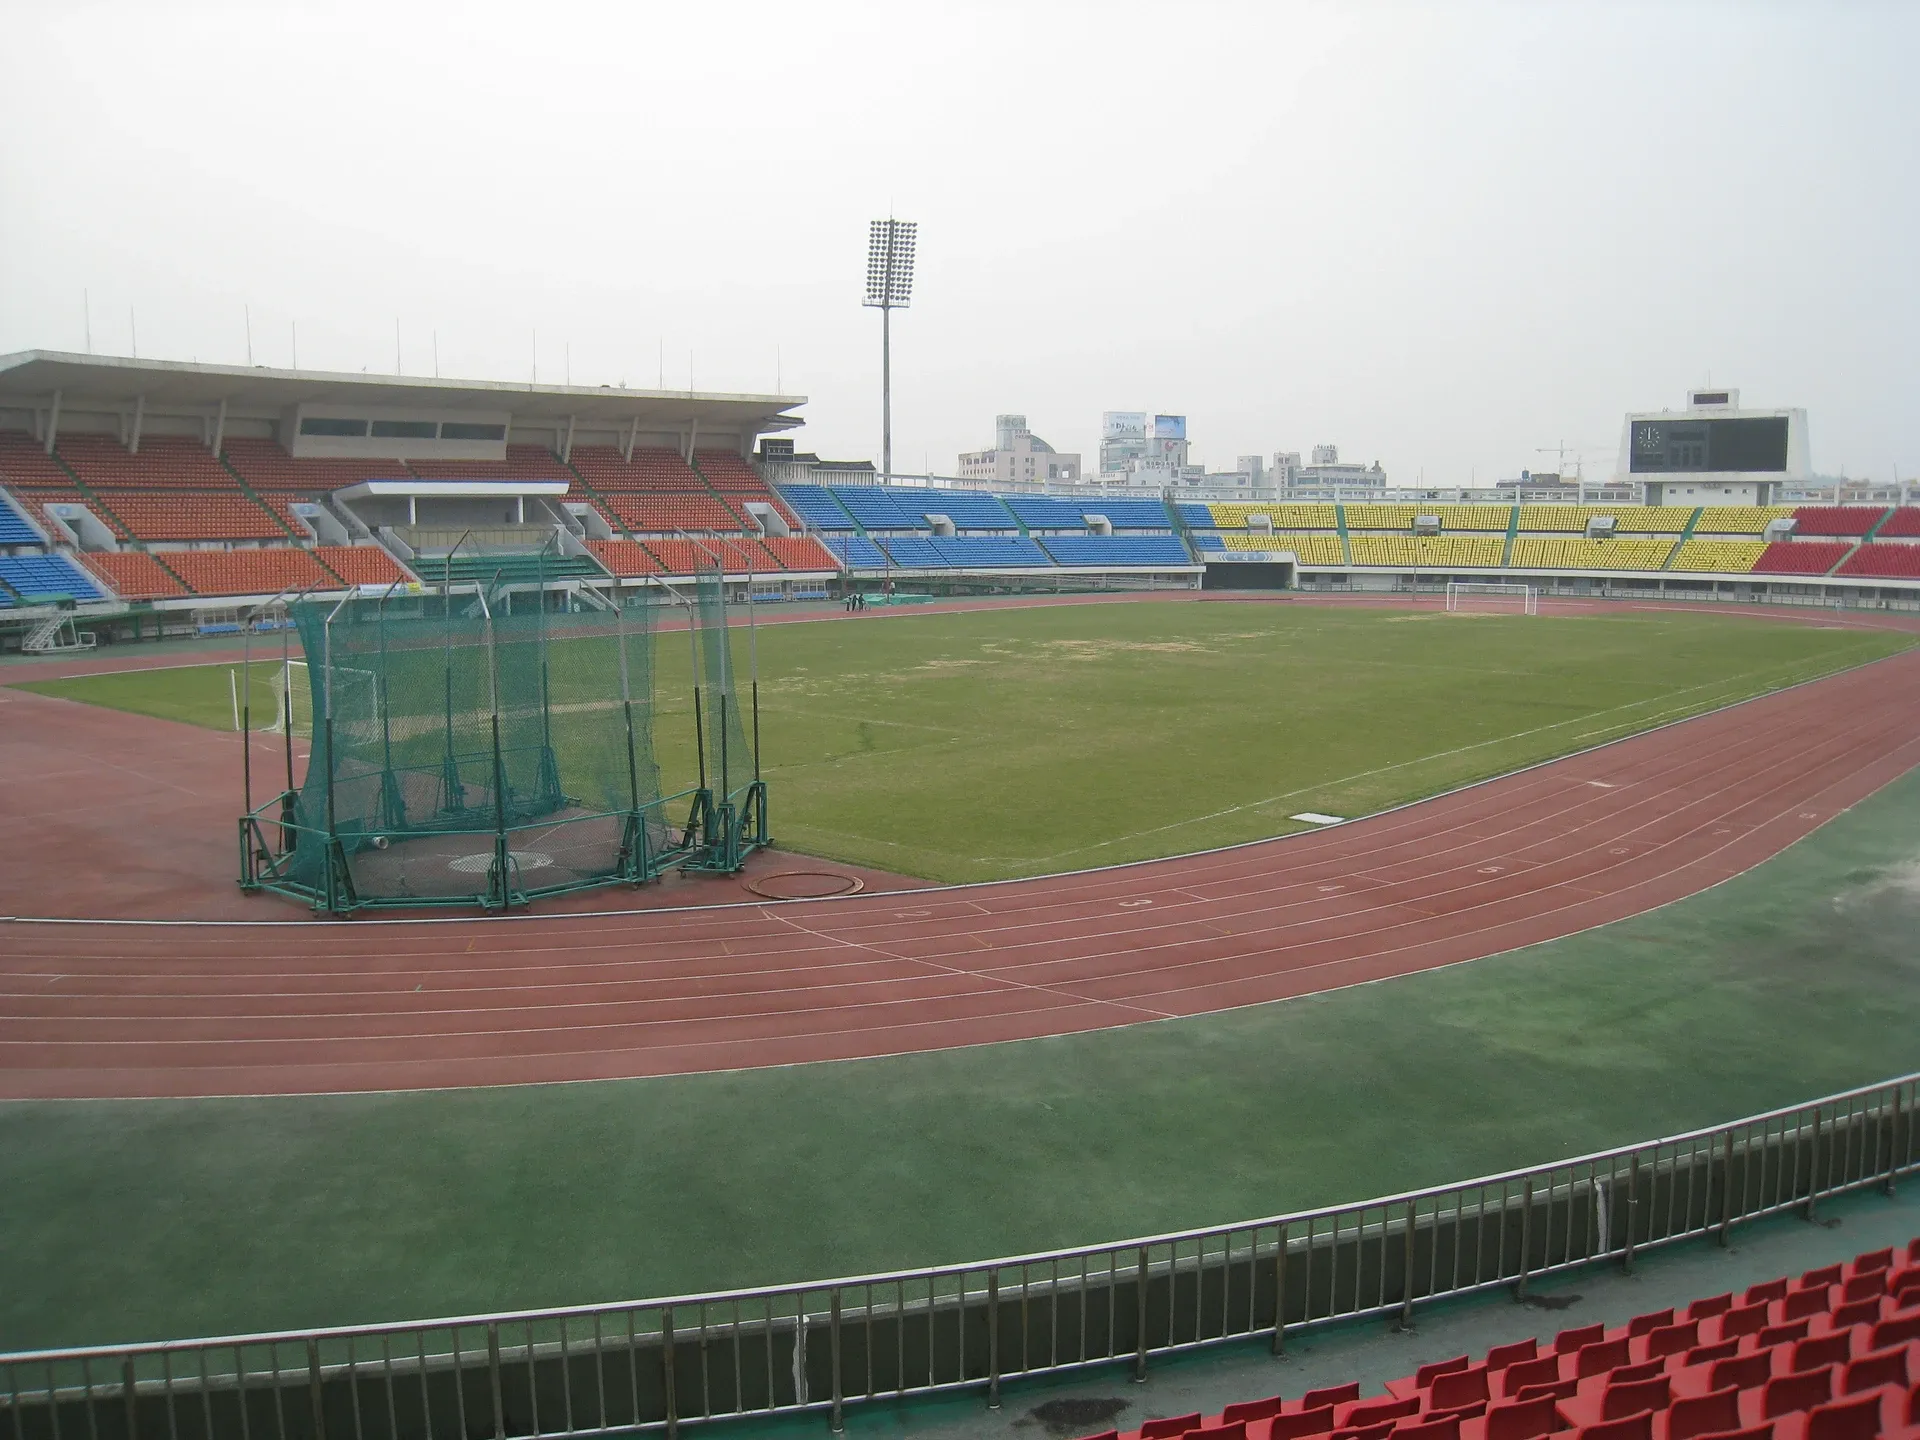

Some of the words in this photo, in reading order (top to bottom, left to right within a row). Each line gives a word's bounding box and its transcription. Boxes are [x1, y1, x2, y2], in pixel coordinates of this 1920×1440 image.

[1242, 553, 1248, 561] 4
[1477, 866, 1505, 874] 5
[1118, 899, 1152, 907] 3
[893, 910, 932, 918] 2
